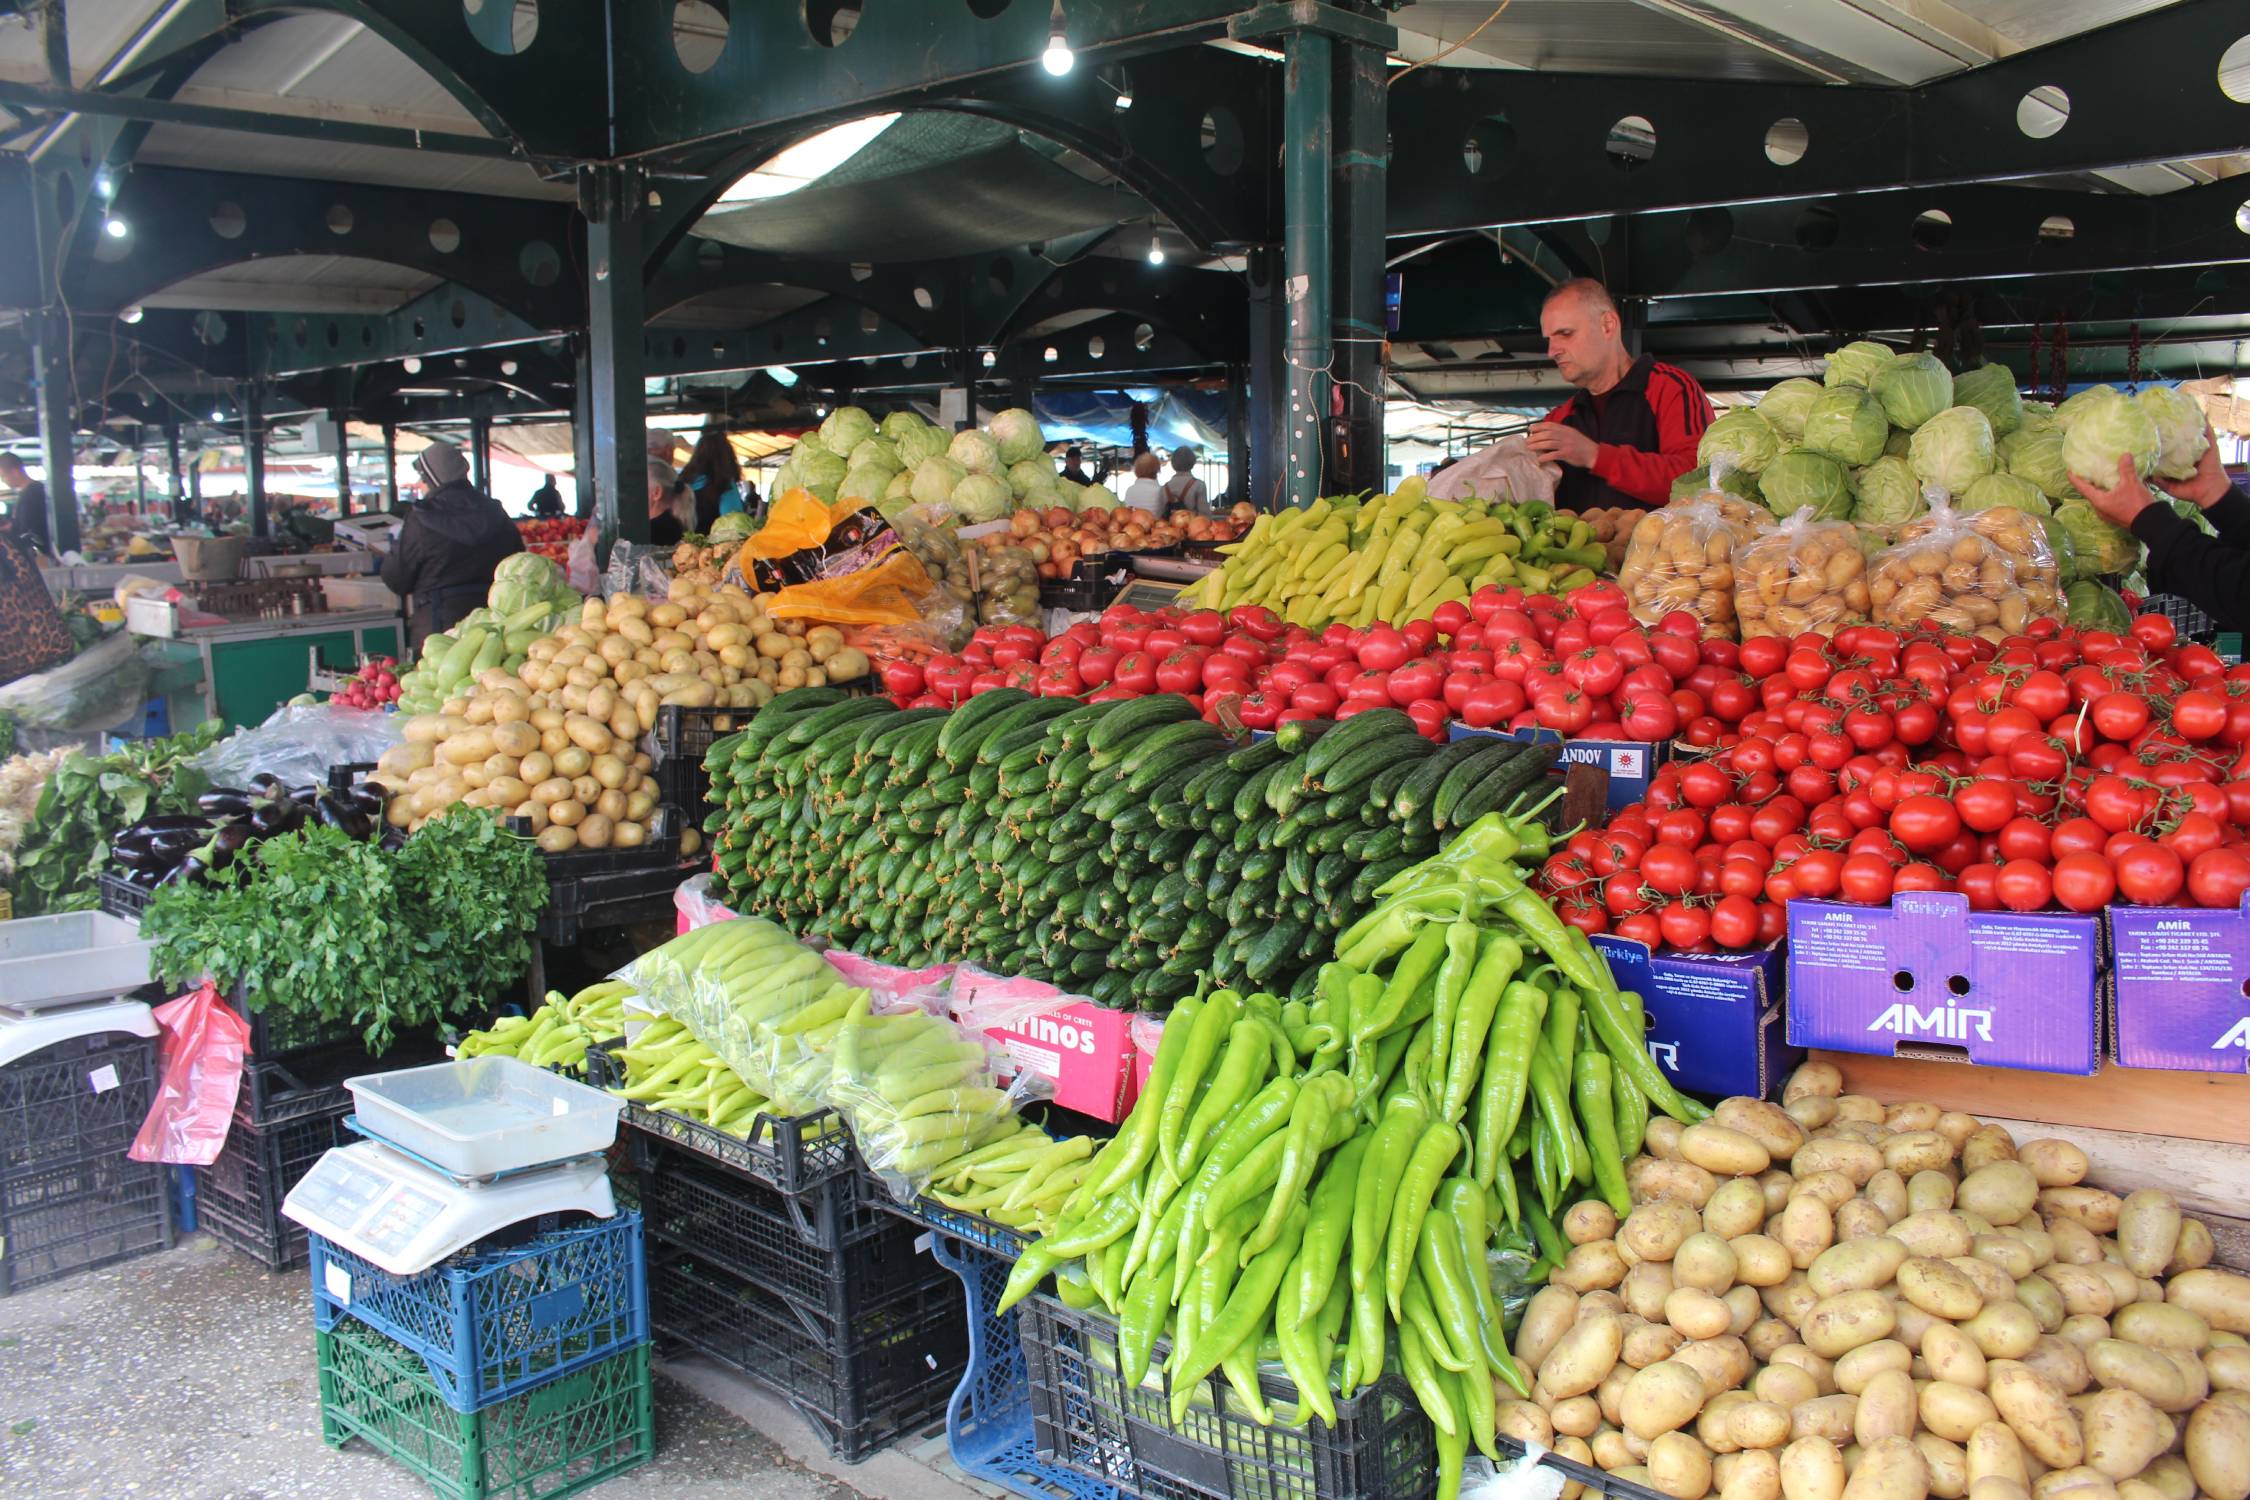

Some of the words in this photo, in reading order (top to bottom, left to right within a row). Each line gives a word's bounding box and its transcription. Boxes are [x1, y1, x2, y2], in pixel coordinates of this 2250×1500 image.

[1558, 748, 1602, 764] ANDOV
[1902, 900, 1958, 918] Türkiye
[1824, 912, 1853, 922] AMİR
[2156, 920, 2191, 930] AMİR
[1073, 1016, 1093, 1027] CRETE
[1866, 998, 1994, 1042] AMİR
